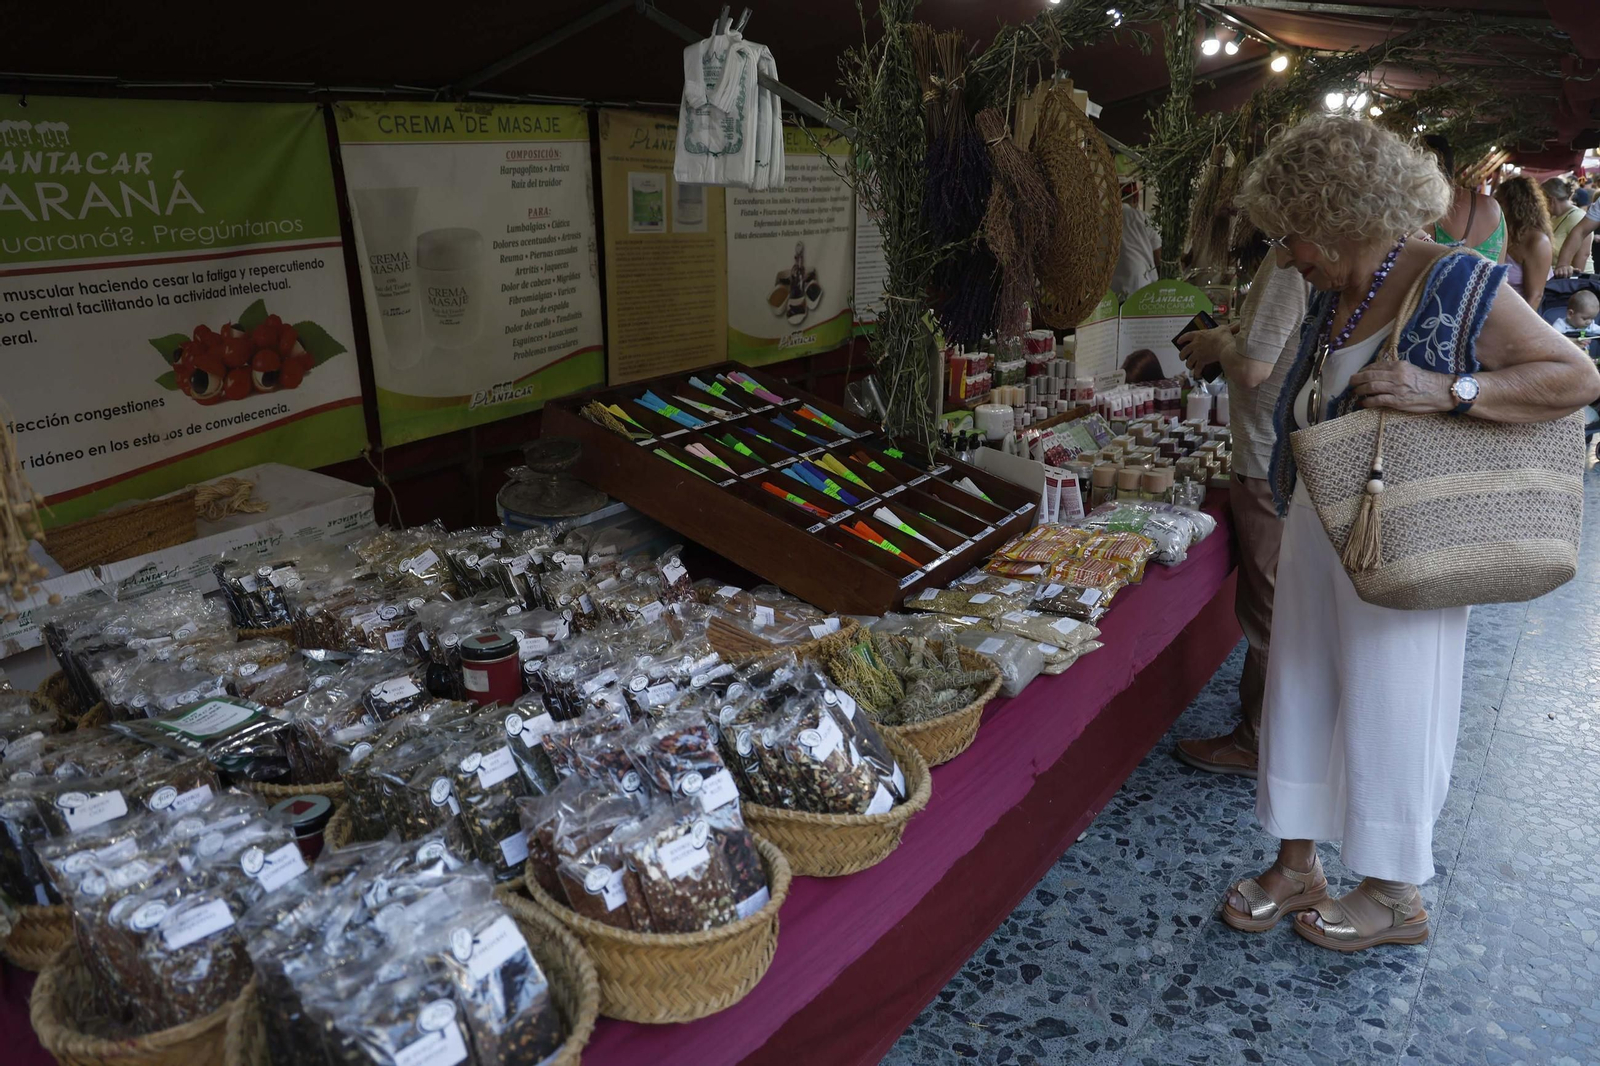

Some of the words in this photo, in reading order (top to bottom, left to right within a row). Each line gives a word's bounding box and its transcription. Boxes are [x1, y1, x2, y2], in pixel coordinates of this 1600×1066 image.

[378, 115, 455, 134] CREMA
[465, 116, 488, 134] DE
[498, 117, 561, 134] MASAJE
[506, 148, 562, 160] COMPOSICIÓN:
[500, 164, 544, 177] Harpagofitos
[527, 179, 537, 188] del
[538, 178, 562, 187] traidor
[528, 207, 551, 218] PARA:
[153, 218, 304, 246] Pregúntanos
[507, 222, 546, 234] Lumbalgias
[493, 239, 519, 250] Dolores
[520, 234, 557, 247] acentuados
[369, 251, 408, 265] CREMA
[500, 253, 524, 264] Reuma
[530, 249, 554, 260] Piernas
[371, 261, 411, 275] MASAJE
[515, 265, 539, 276] Artritis
[3, 284, 75, 302] muscular
[79, 276, 149, 295] haciendo
[153, 274, 189, 288] cesar
[193, 270, 204, 284] la
[207, 267, 237, 284] fatiga
[240, 268, 247, 281] y
[249, 258, 325, 277] repercutiendo
[501, 282, 520, 293] Dolor
[521, 281, 529, 290] de
[530, 278, 552, 289] cabeza
[20, 303, 74, 321] central
[77, 294, 154, 315] facilitando
[158, 291, 170, 306] la
[174, 284, 227, 303] actividad
[230, 278, 292, 297] intelectual.
[428, 287, 466, 298] CREMA
[509, 291, 553, 305] Fibromialgias
[428, 295, 469, 307] MASAJE
[521, 307, 539, 317] Dolor
[540, 304, 547, 313] de
[548, 300, 570, 313] espalda
[505, 323, 524, 335] Dolor
[525, 320, 532, 330] de
[533, 317, 552, 328] cuello
[1, 330, 38, 347] eral.
[513, 334, 543, 348] Esguinces
[514, 347, 547, 360] Problemas
[548, 339, 579, 351] musculares
[470, 385, 533, 410] PLANTACAR
[74, 397, 166, 423] congestiones
[30, 451, 84, 468] idóneo
[89, 444, 107, 457] en
[110, 440, 130, 452] los
[187, 423, 203, 436] de
[206, 404, 290, 431] convalecencia.
